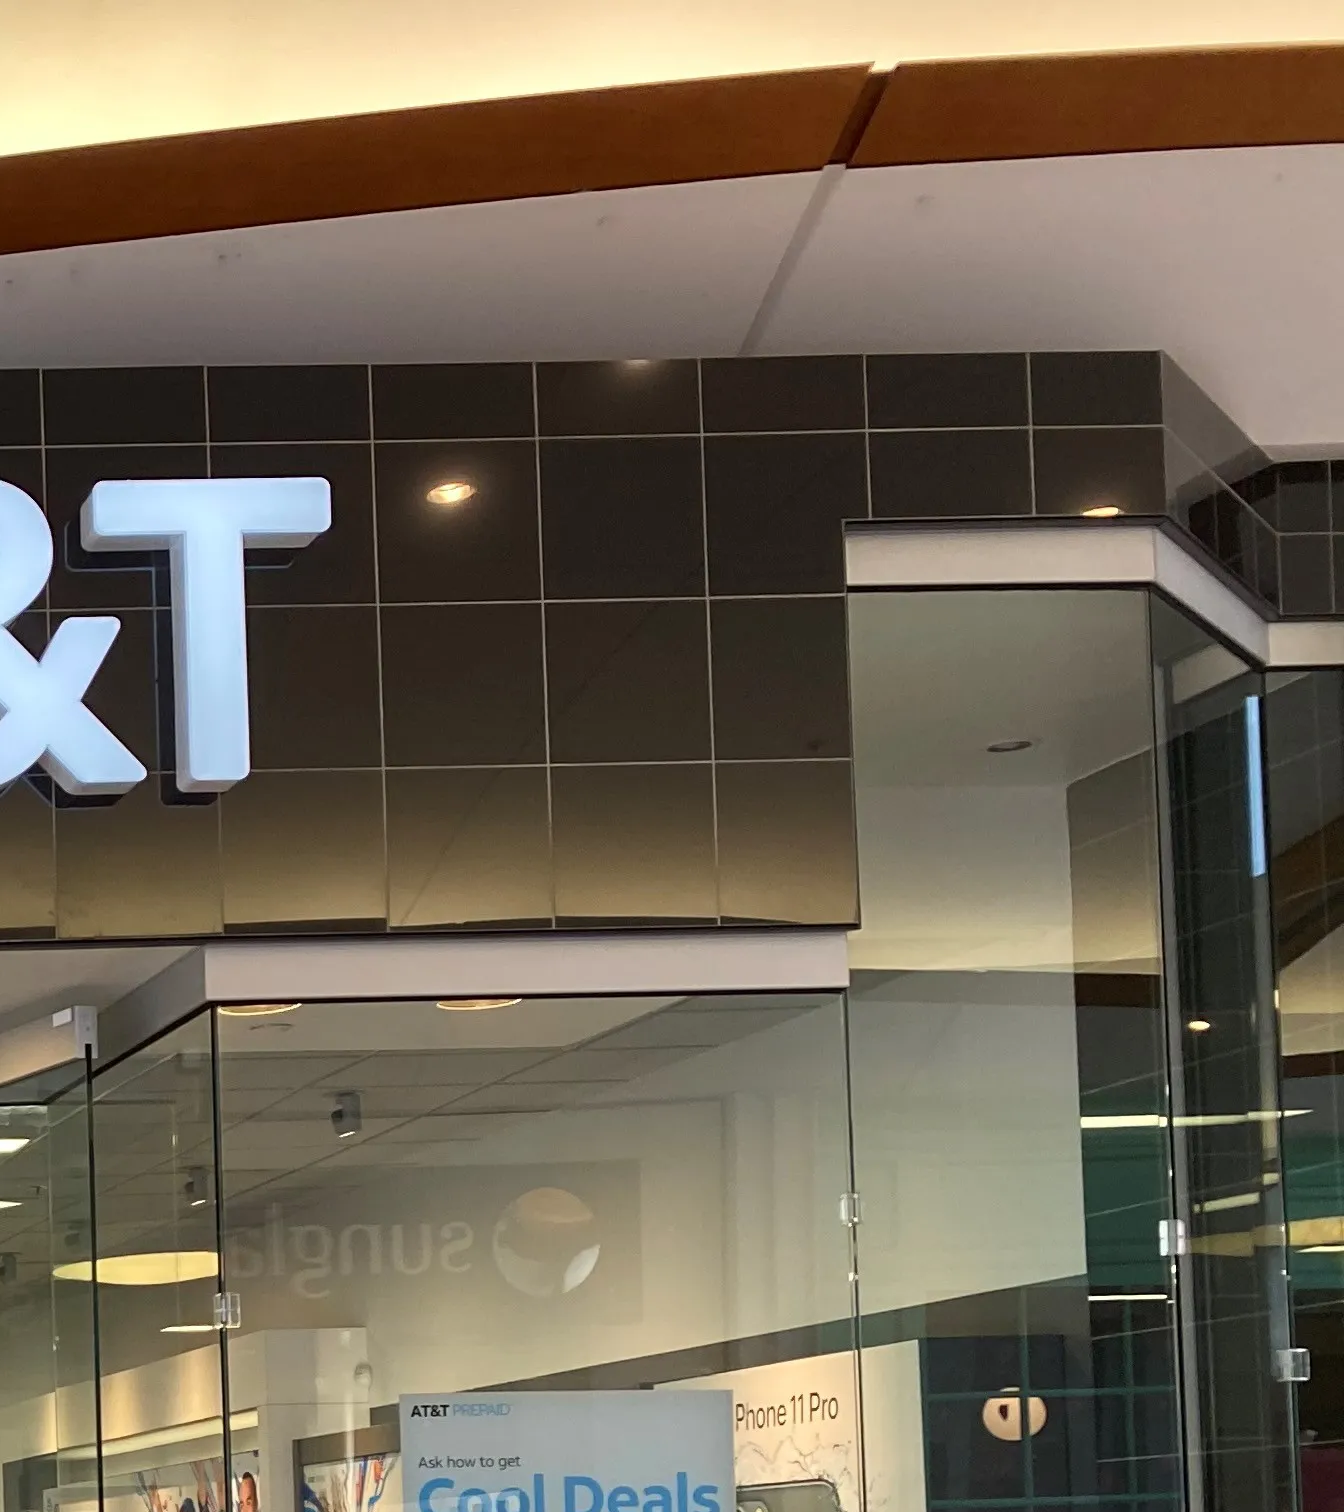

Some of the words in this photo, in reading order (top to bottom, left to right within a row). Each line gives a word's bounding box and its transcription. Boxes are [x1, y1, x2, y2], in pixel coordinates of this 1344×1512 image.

[410, 1404, 449, 1418] AT&T
[452, 1404, 511, 1417] PREPAID
[735, 1403, 787, 1432] Phone
[790, 1394, 804, 1424] 11
[809, 1392, 839, 1422] Pro
[418, 1456, 443, 1469] Ask
[447, 1456, 476, 1468] how
[479, 1457, 494, 1468] to
[498, 1456, 521, 1470] get
